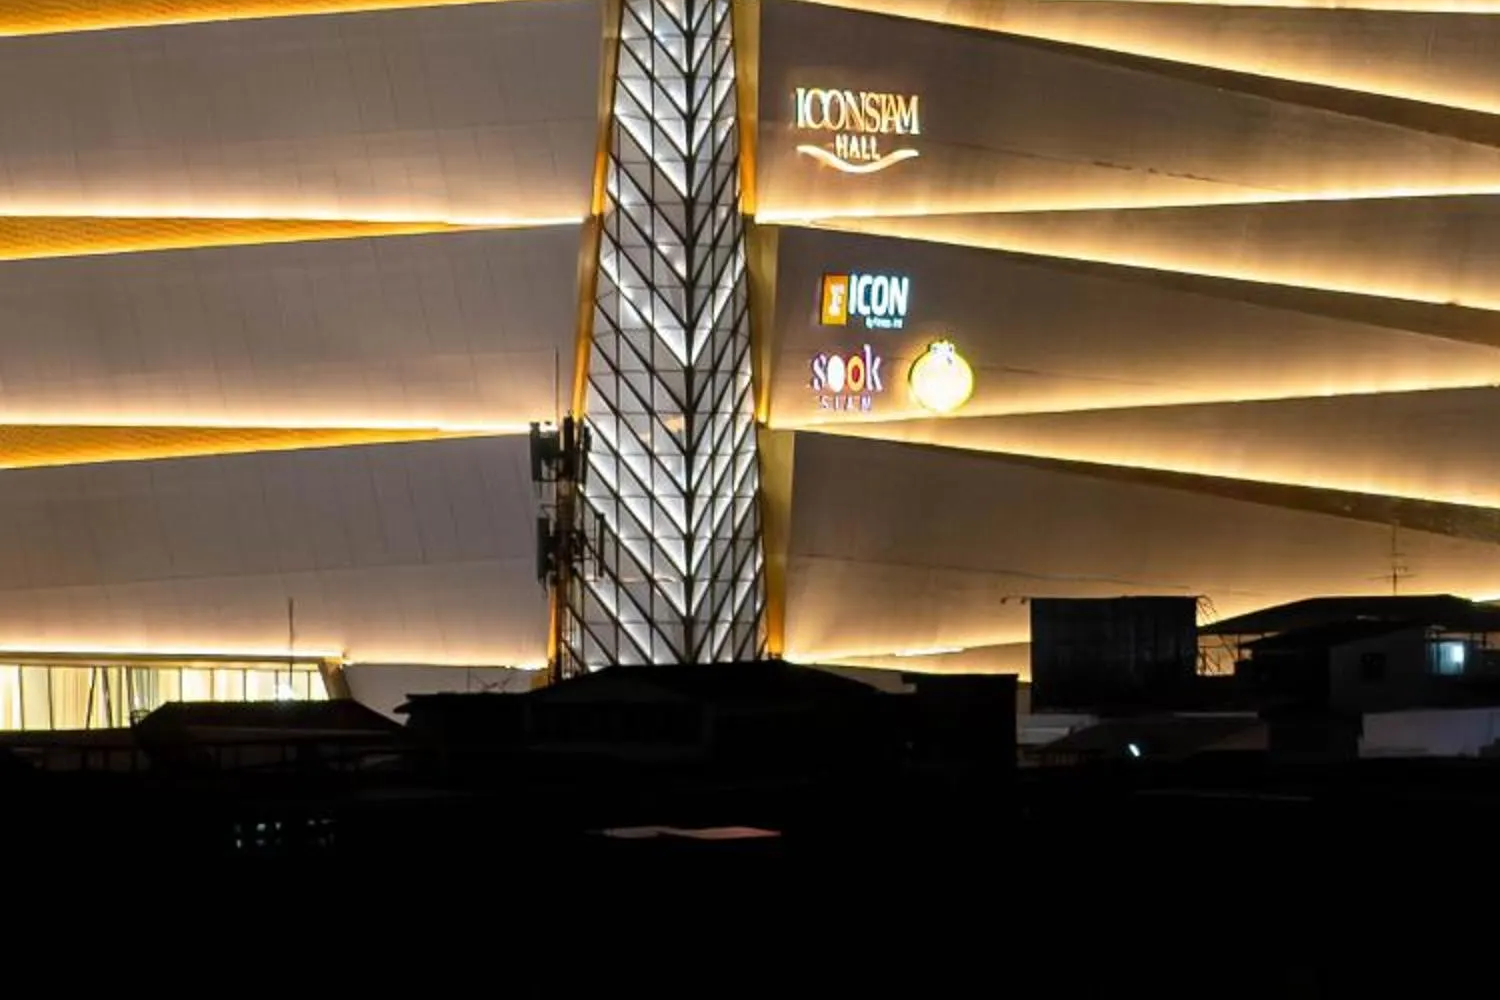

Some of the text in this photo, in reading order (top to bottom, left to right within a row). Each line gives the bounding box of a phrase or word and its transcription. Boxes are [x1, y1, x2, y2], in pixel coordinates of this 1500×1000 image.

[795, 87, 920, 135] ICONSIAM
[834, 133, 881, 161] HALL
[849, 274, 909, 317] ICON
